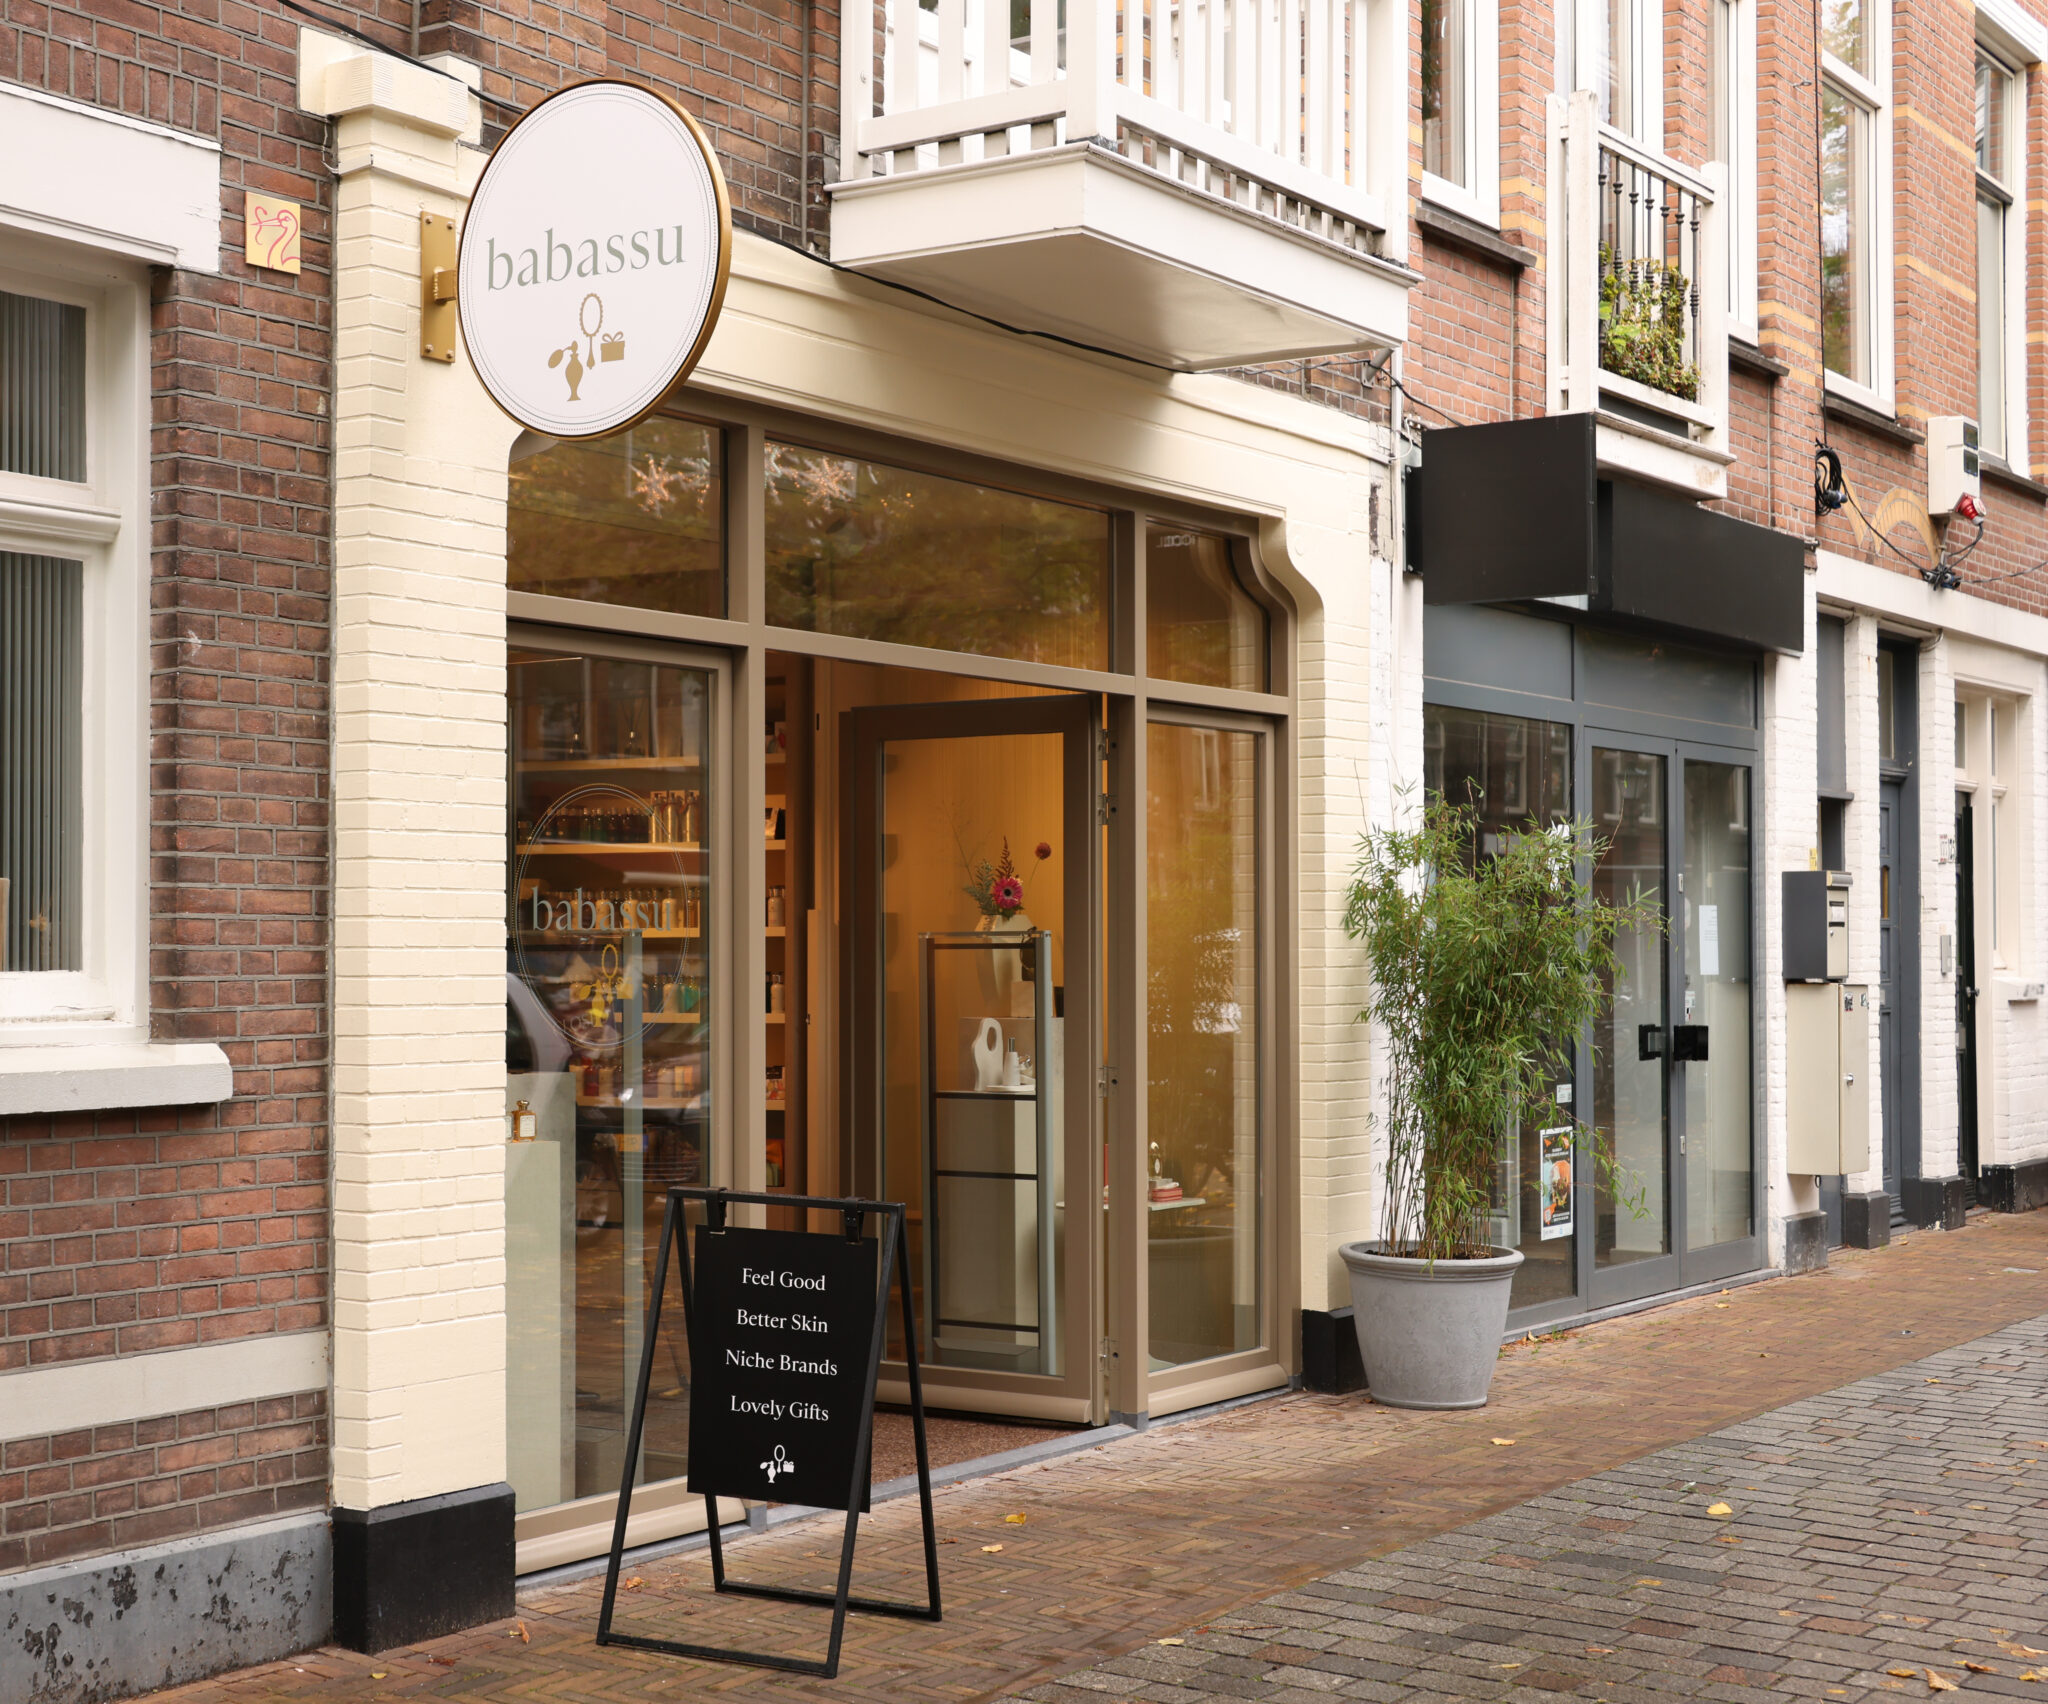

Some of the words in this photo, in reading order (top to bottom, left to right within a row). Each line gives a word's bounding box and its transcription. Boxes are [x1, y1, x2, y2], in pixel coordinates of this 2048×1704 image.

[486, 224, 688, 292] babassu
[531, 886, 673, 933] babassu
[742, 1267, 775, 1287] Feel
[779, 1271, 826, 1291] Good
[736, 1308, 788, 1329] Better
[791, 1313, 828, 1333] Skin
[725, 1348, 775, 1370] Niche
[779, 1354, 838, 1376] Brands
[730, 1395, 785, 1421] Lovely
[789, 1401, 829, 1422] Gifts
